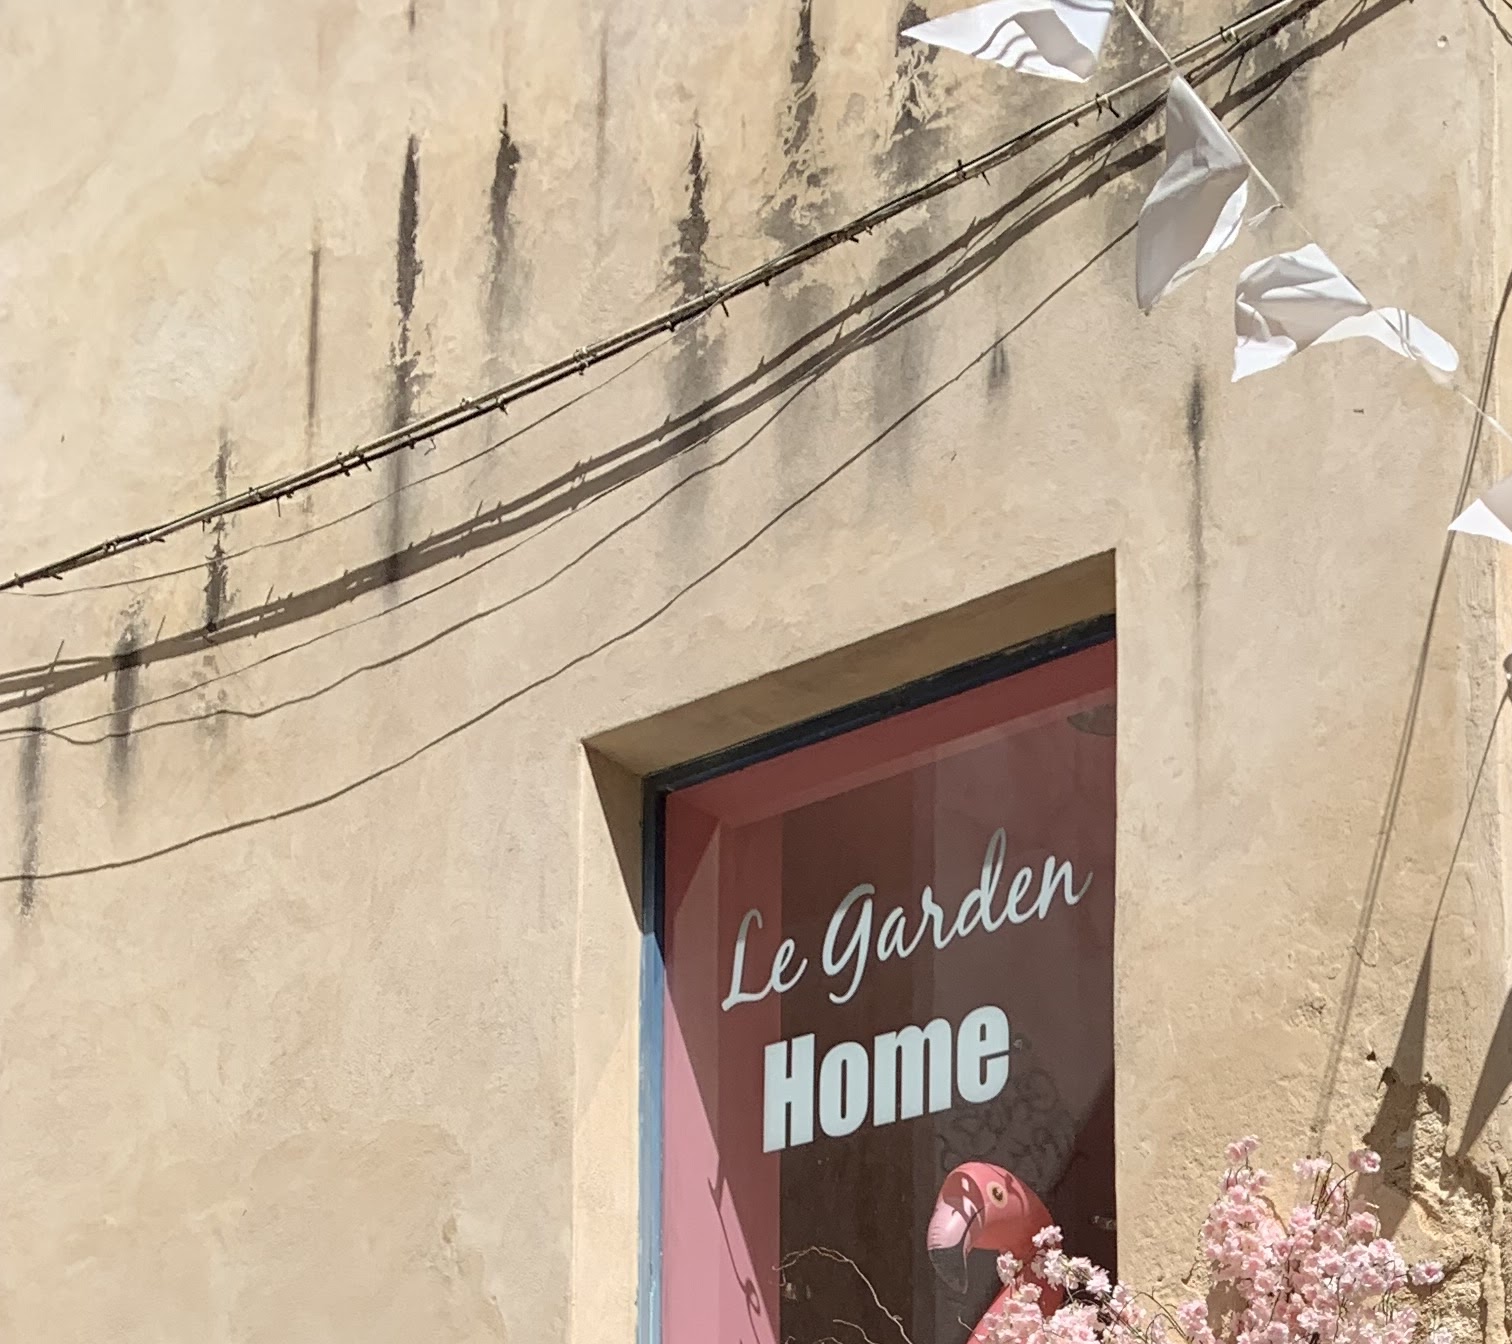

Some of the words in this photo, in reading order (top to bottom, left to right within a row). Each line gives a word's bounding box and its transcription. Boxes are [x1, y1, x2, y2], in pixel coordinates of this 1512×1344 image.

[721, 908, 807, 1011] Le
[821, 827, 1094, 1004] Garden
[762, 1005, 1011, 1154] Home
